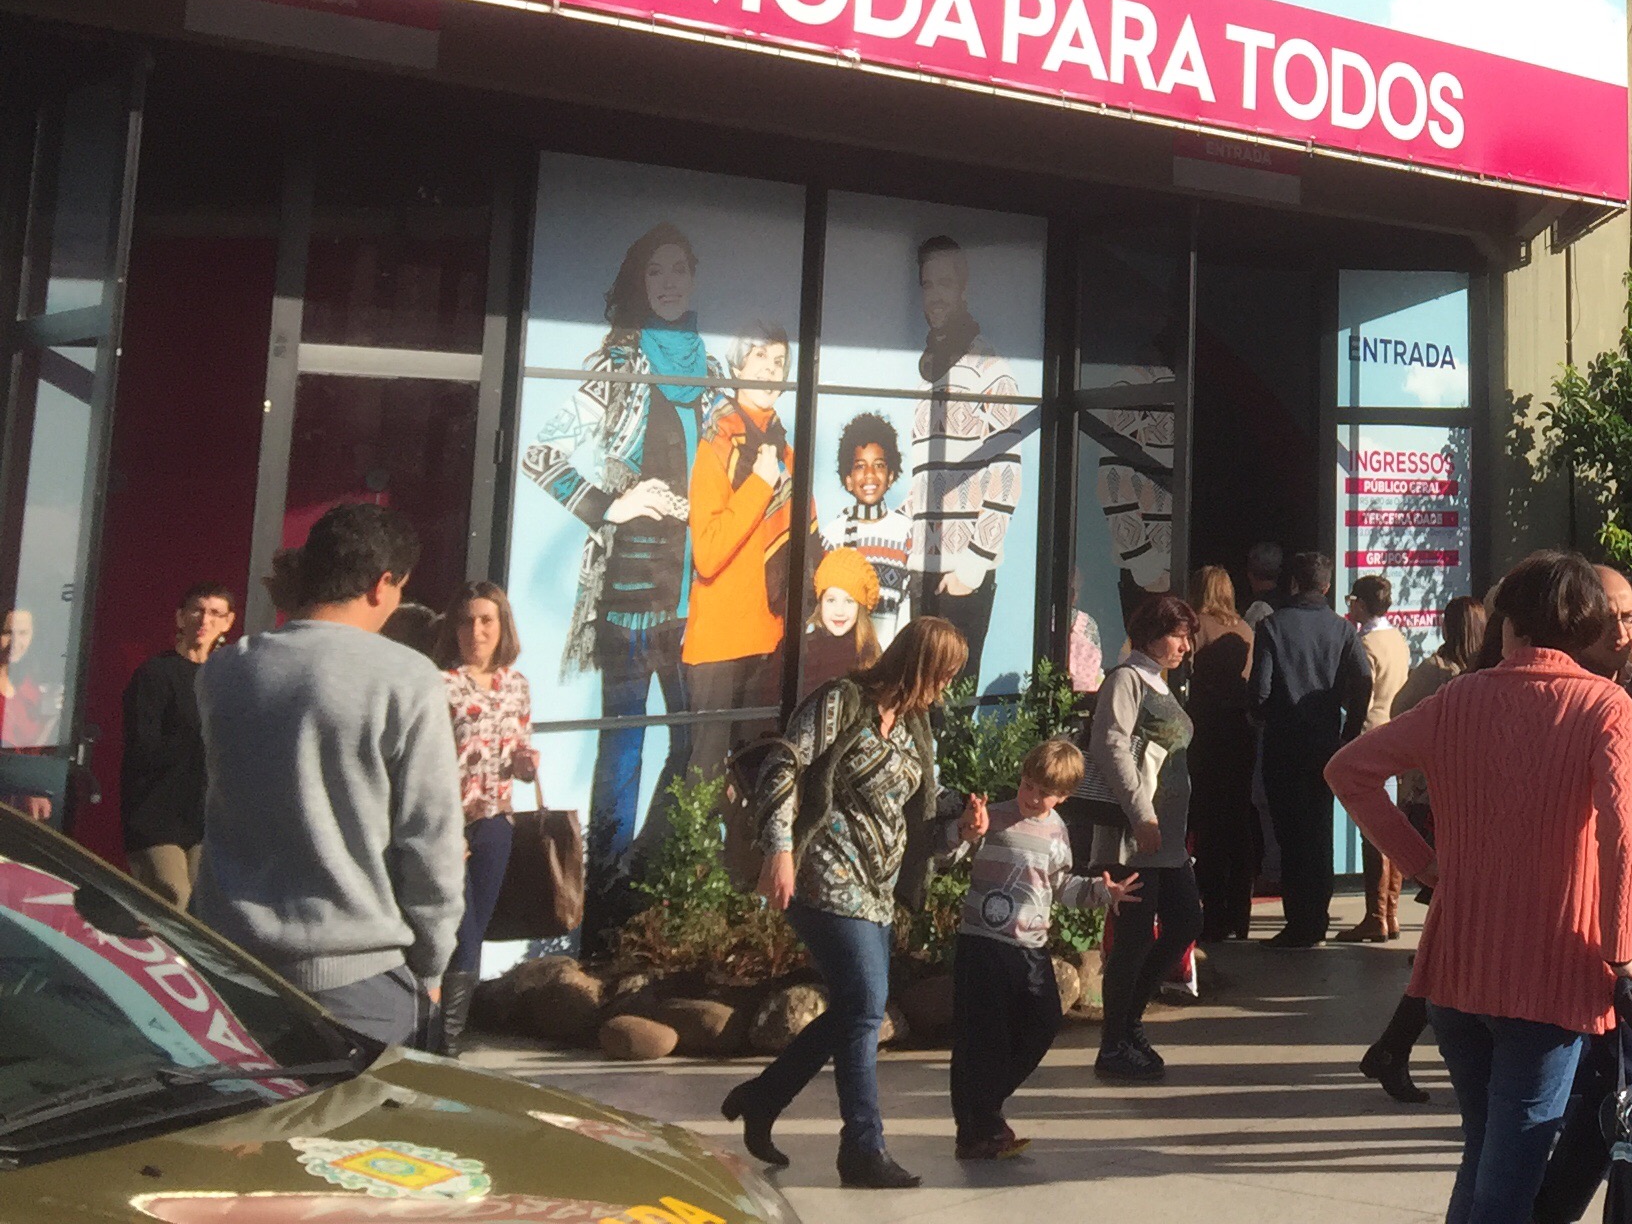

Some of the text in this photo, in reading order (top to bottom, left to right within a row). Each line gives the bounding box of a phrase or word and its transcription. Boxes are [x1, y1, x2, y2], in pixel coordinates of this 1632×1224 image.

[1225, 23, 1465, 150] TODOS
[1205, 140, 1272, 166] ENTRADA
[1348, 334, 1456, 371] ENTRADA
[1348, 449, 1456, 475] INGRESSOS
[1363, 479, 1408, 493] PÚBLICO
[1363, 512, 1413, 525] TERCEIRA
